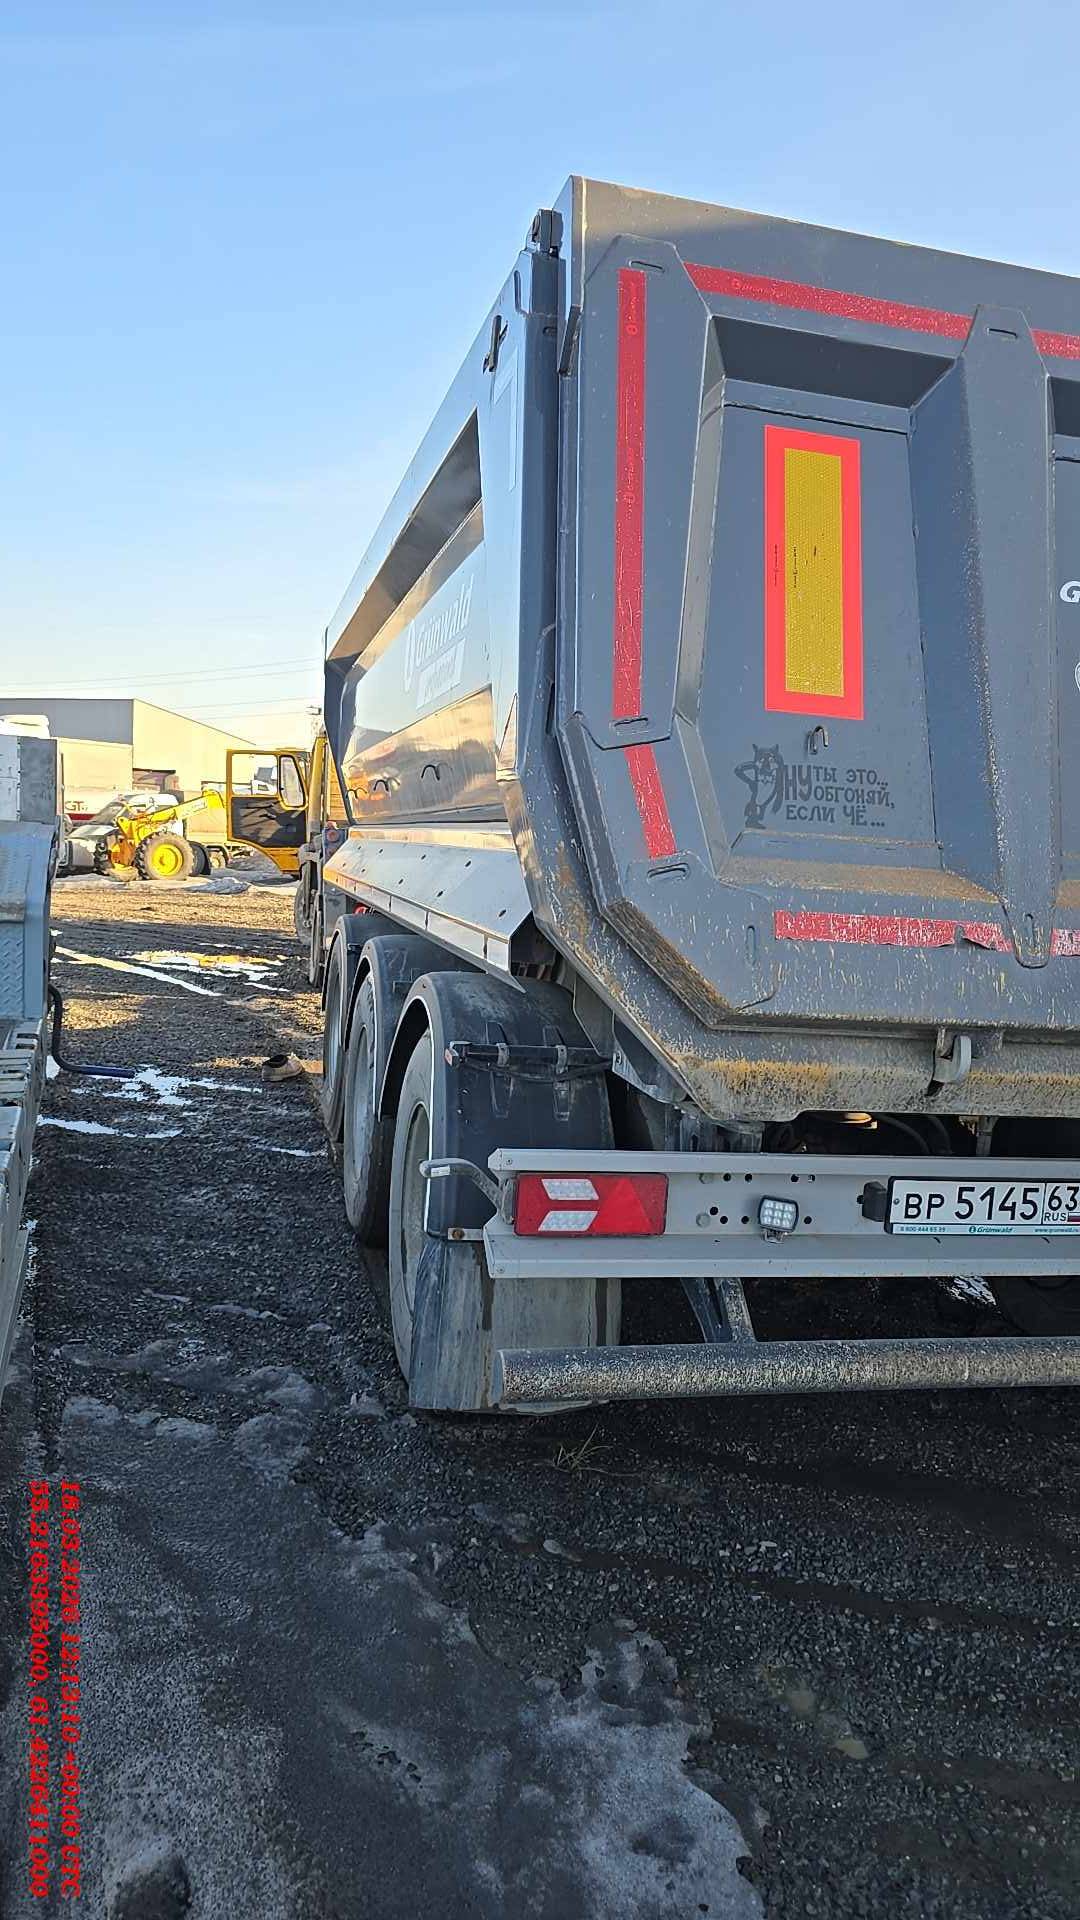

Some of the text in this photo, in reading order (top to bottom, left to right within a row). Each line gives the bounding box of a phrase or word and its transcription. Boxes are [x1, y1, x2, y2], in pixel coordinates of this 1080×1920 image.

[784, 764, 889, 801] НУ ТЫ ЭТО...
[813, 786, 895, 809] ОБГОНЯЙ,
[786, 805, 835, 823] ЕСЛИ
[954, 1186, 1040, 1221] 5145
[1044, 1212, 1067, 1222] RUS
